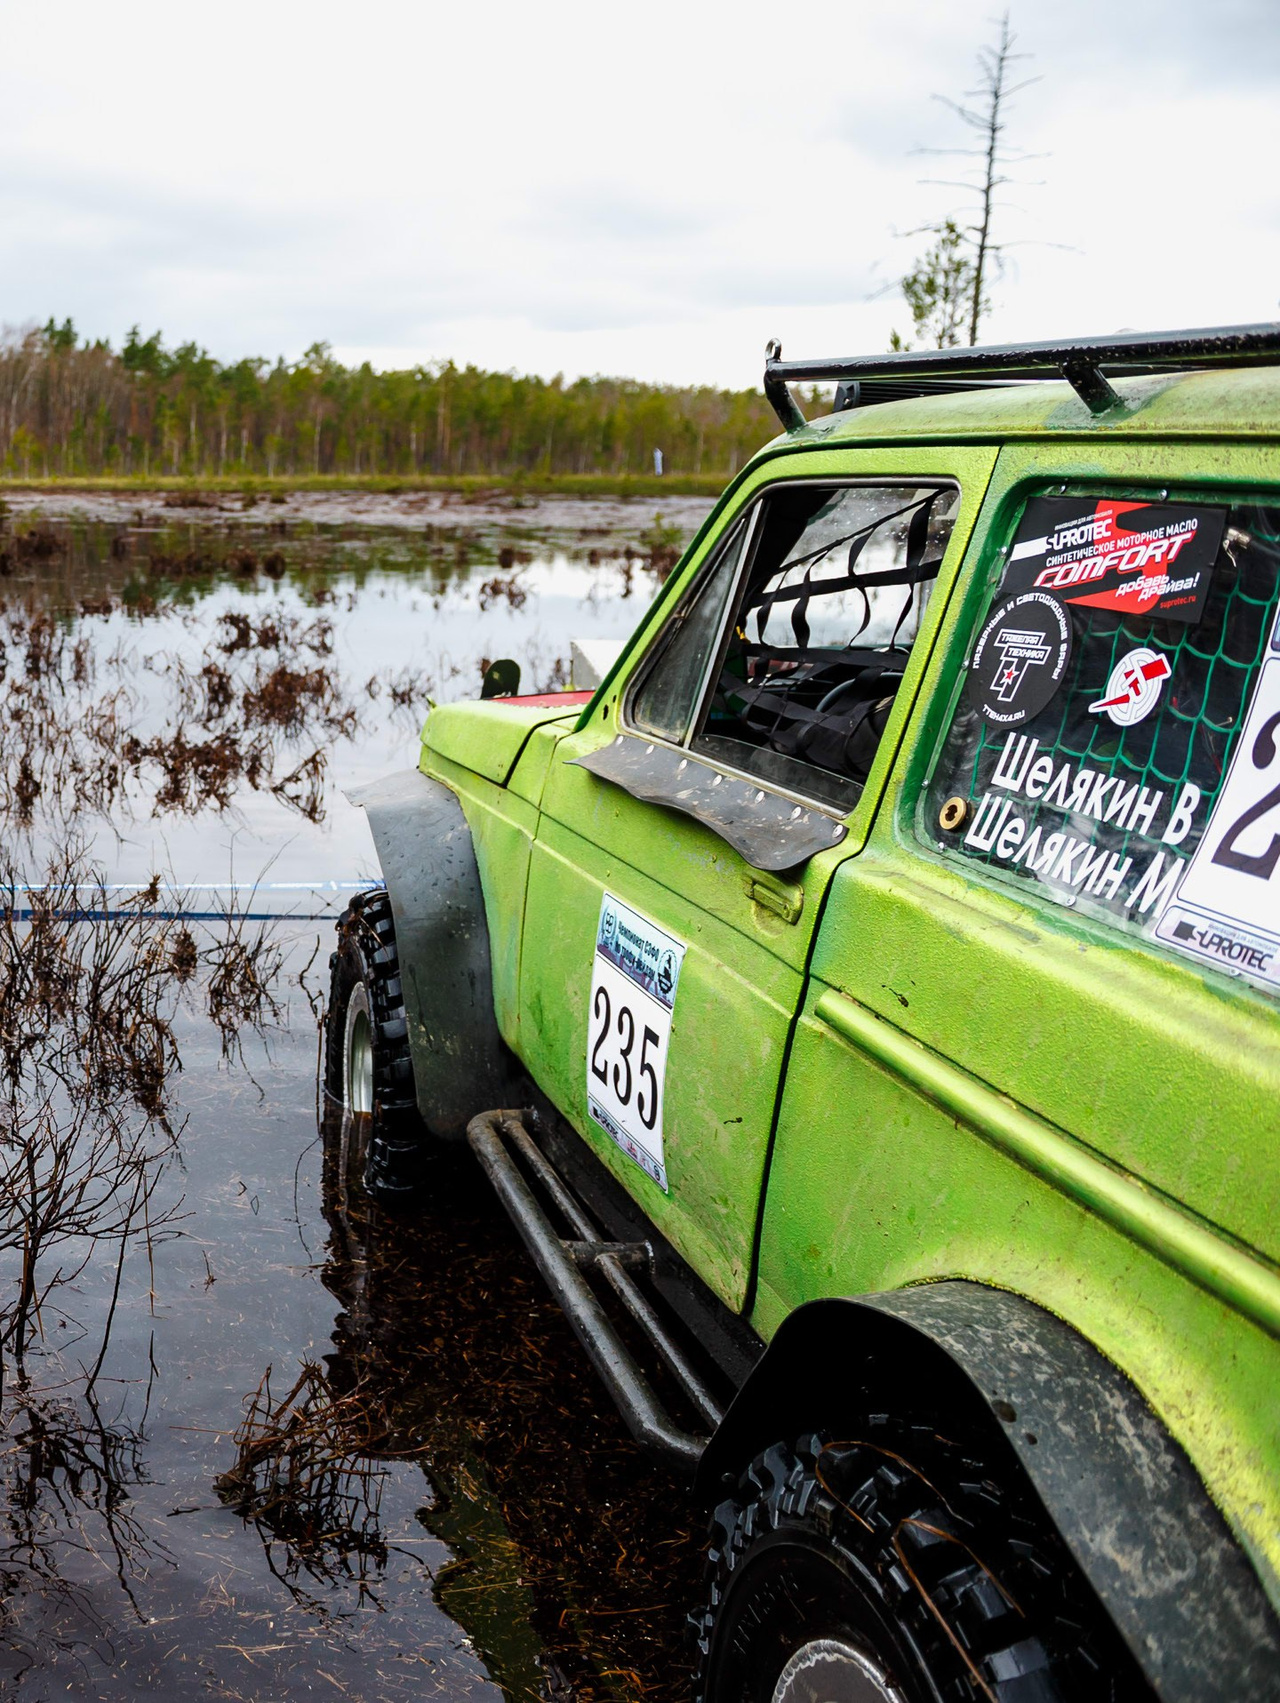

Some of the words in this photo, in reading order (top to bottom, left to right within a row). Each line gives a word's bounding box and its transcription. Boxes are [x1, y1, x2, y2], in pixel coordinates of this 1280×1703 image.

[1033, 533, 1193, 588] COMFORT
[1046, 541, 1115, 568] СИНТЕТИЧЕСКОЕ
[1117, 528, 1164, 549] МОТОРНОЕ
[1166, 518, 1199, 537] МАСЛО
[1006, 600, 1015, 612] И
[1115, 575, 1170, 598] добавь
[1138, 572, 1201, 602] драйва!
[991, 732, 1164, 836] Шелякин
[1161, 782, 1201, 846] В
[964, 792, 1134, 900] Шелякин
[1124, 850, 1186, 919] М
[592, 986, 660, 1130] 235
